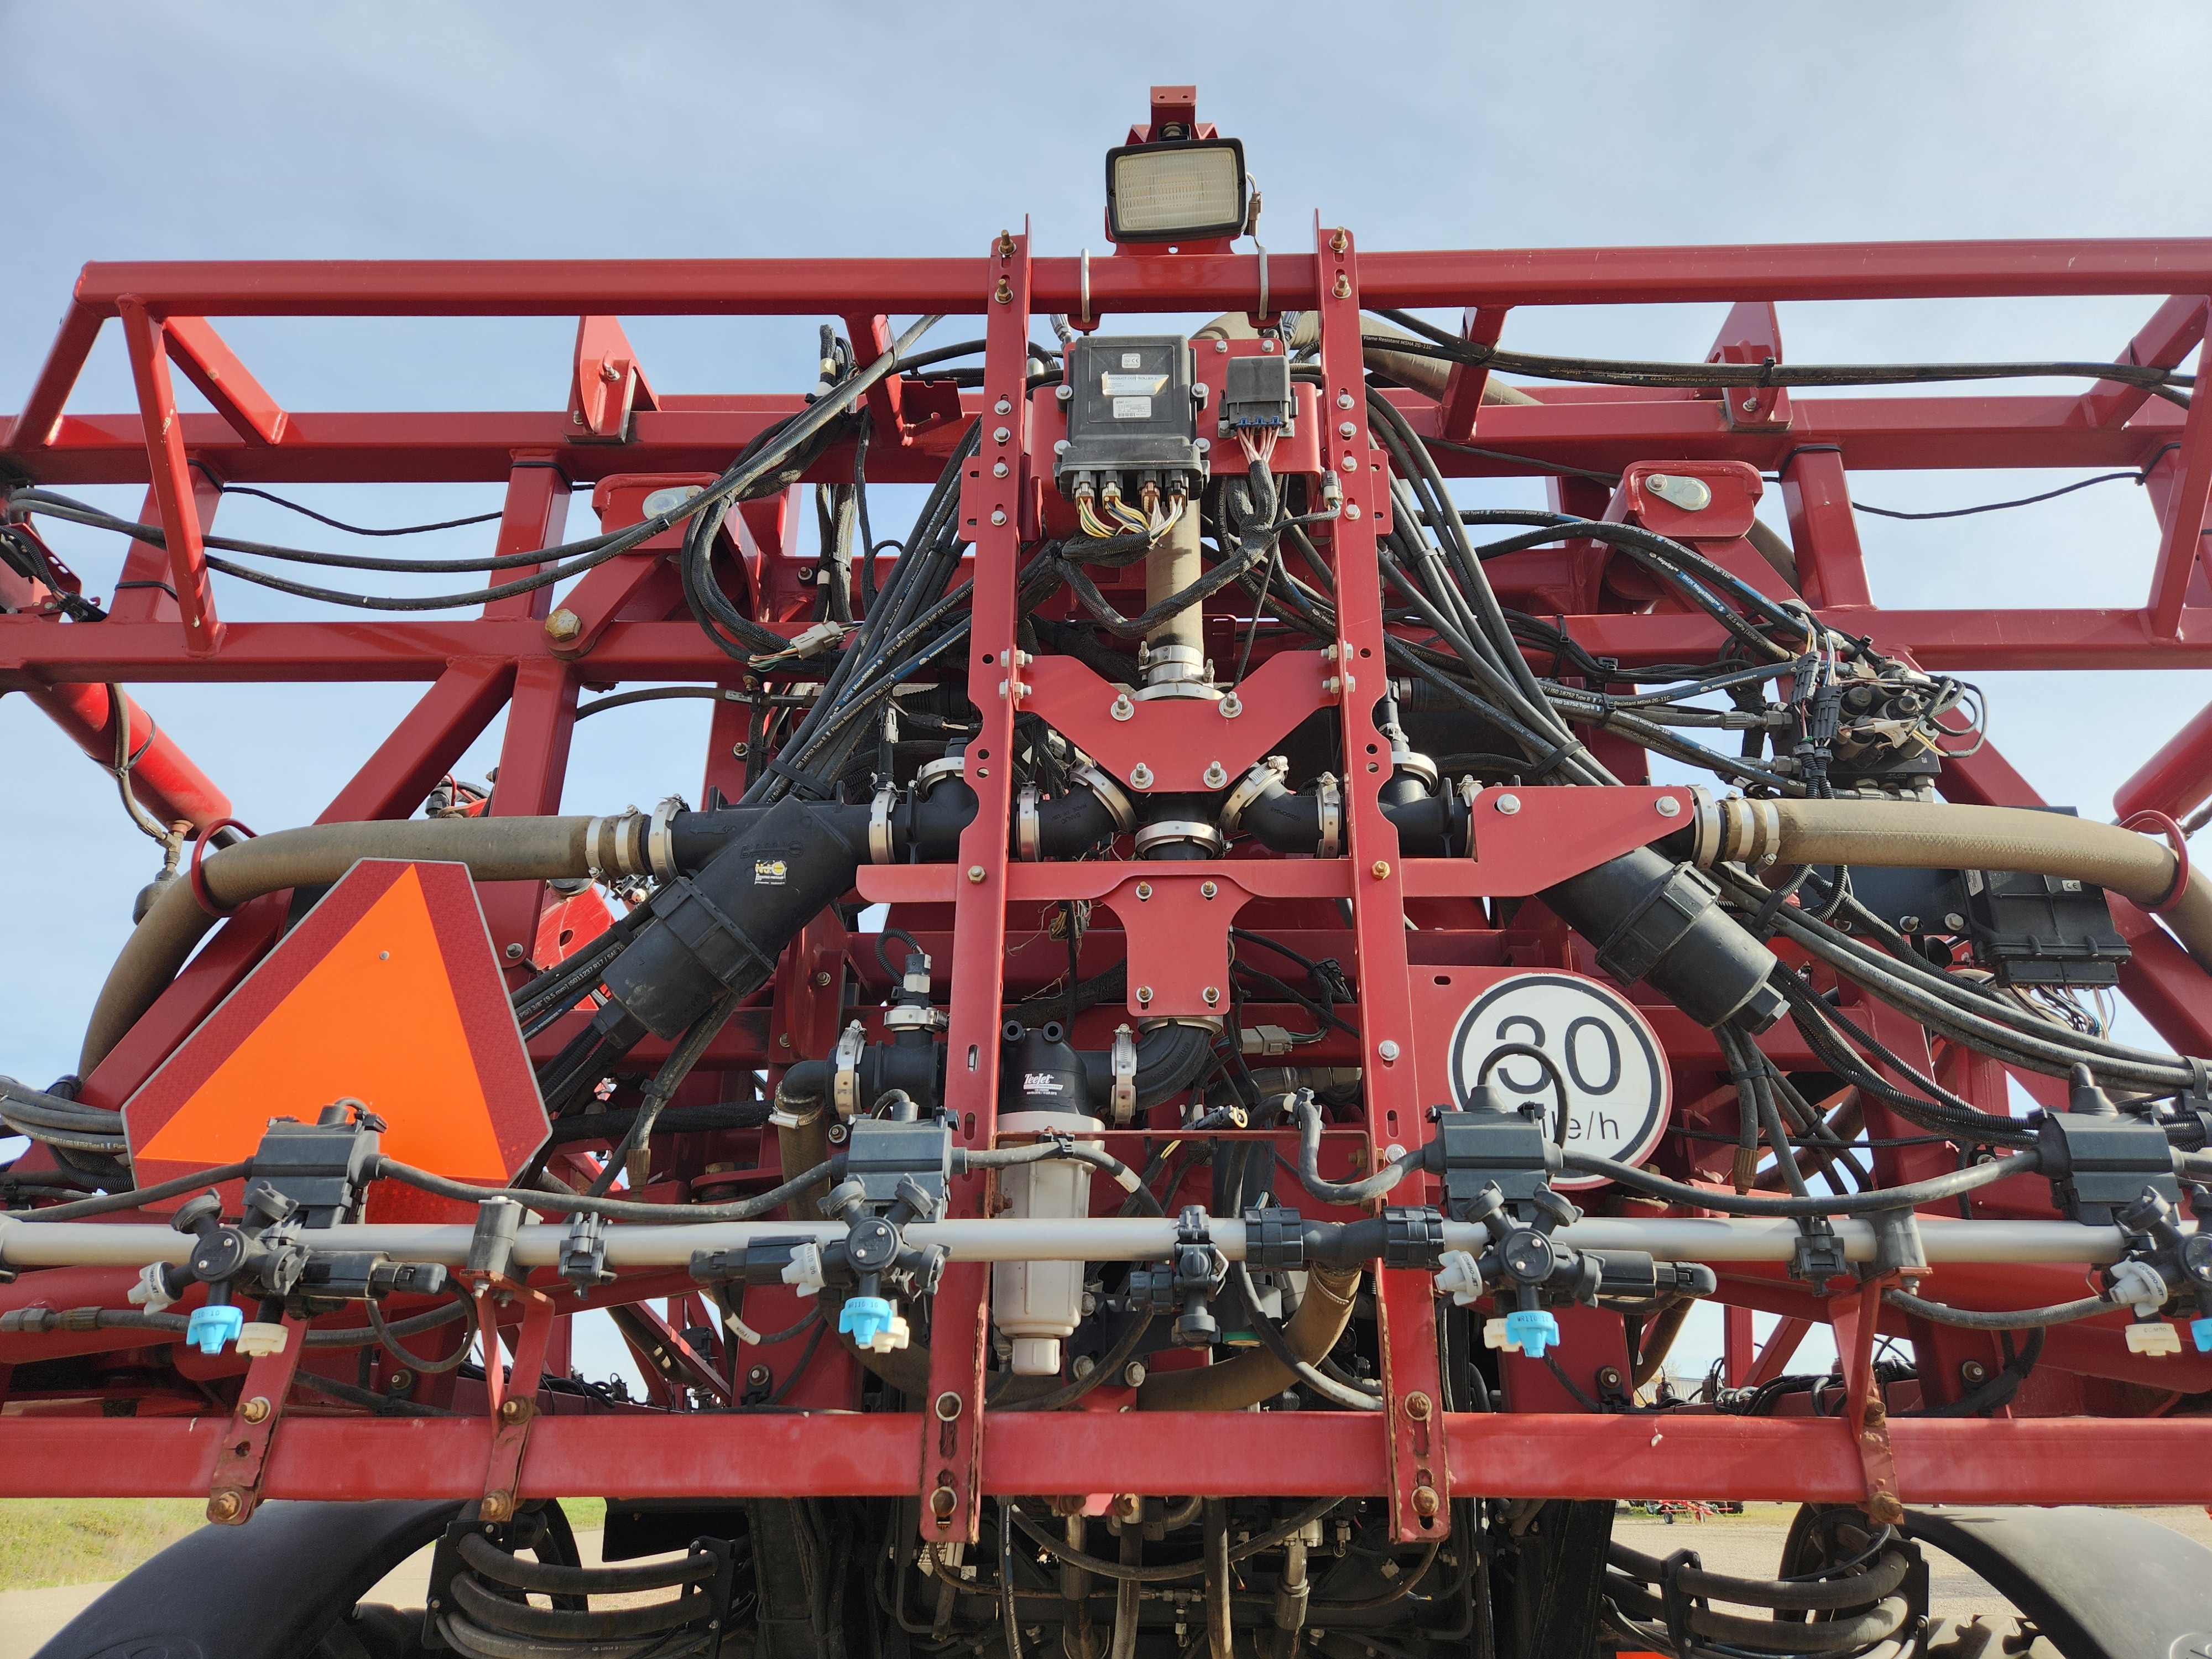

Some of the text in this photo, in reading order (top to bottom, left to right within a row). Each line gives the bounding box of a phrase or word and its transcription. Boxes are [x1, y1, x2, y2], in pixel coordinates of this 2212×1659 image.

[1664, 539, 1679, 549] Flame
[1678, 546, 1701, 561] Resistant
[1700, 558, 1714, 570] MSHA
[1726, 613, 1736, 624] 22.5
[886, 646, 898, 657] 22.5
[896, 639, 907, 649] MPa
[795, 761, 804, 770] ISO
[802, 749, 815, 763] 18752
[812, 740, 824, 751] Type
[831, 719, 844, 732] Flame
[843, 703, 864, 722] Resistant
[863, 695, 877, 706] MSHA
[875, 681, 894, 696] 2G-11C
[929, 643, 948, 658] POWERING
[1559, 690, 1575, 698] 18752
[1575, 693, 1587, 702] Type
[1651, 695, 1671, 704] 2G-11C
[1711, 679, 1732, 690] POWERING
[1617, 711, 1639, 723] Resistant
[1639, 718, 1653, 728] MSHA
[1653, 723, 1672, 735] 2G-11C
[1709, 750, 1730, 763] POWERING
[740, 840, 805, 859] BANJO
[567, 965, 594, 987] ISO11237
[593, 958, 604, 970] R17
[607, 949, 619, 960] SAE
[1496, 1015, 1621, 1096] 30
[1024, 1073, 1051, 1086] TeeJet
[1541, 1110, 1619, 1140] ile/h
[1462, 1255, 1478, 1288] COMBO-JET
[2138, 1265, 2164, 1298] COMBO-JET
